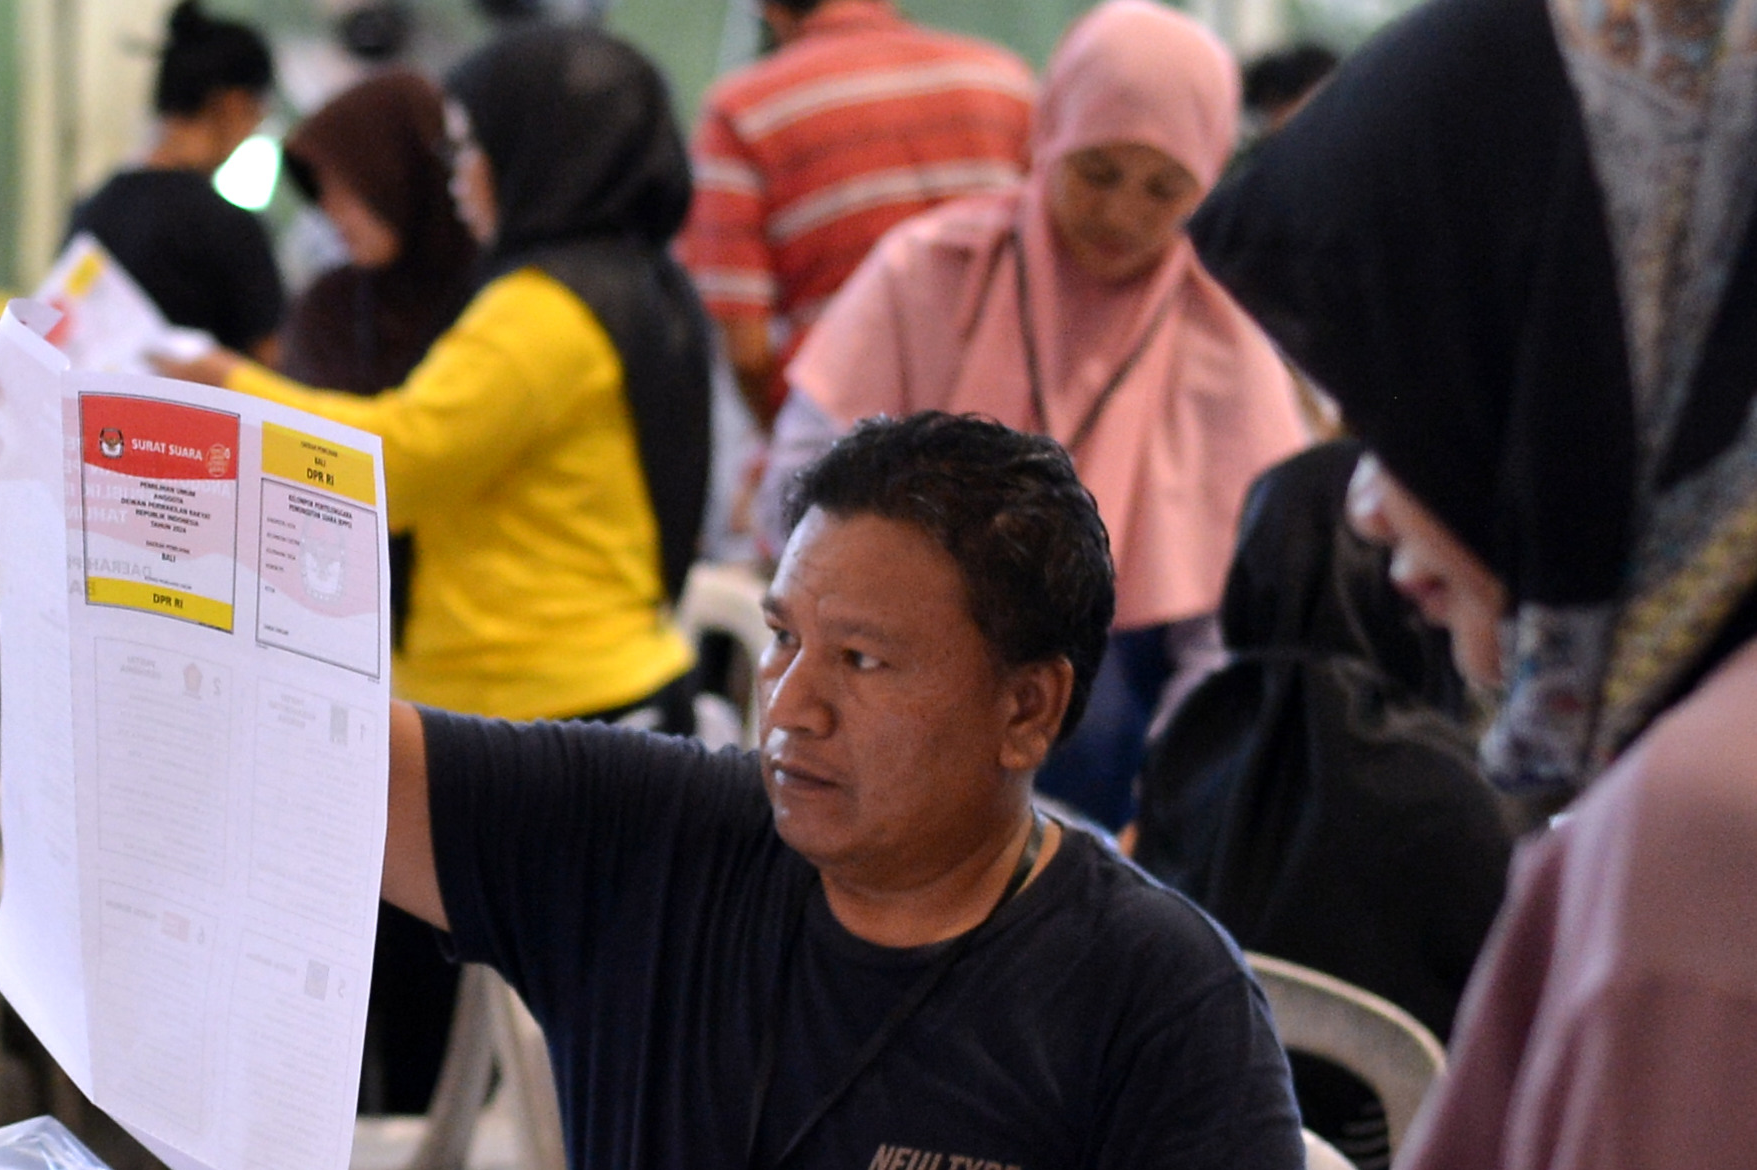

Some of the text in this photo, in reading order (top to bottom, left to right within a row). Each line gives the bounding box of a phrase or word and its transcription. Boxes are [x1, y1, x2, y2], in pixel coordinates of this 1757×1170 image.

[132, 438, 203, 461] SURAT SUARA
[307, 468, 334, 486] DPR RI
[162, 552, 176, 563] BALI
[153, 593, 184, 609] DPR RI
